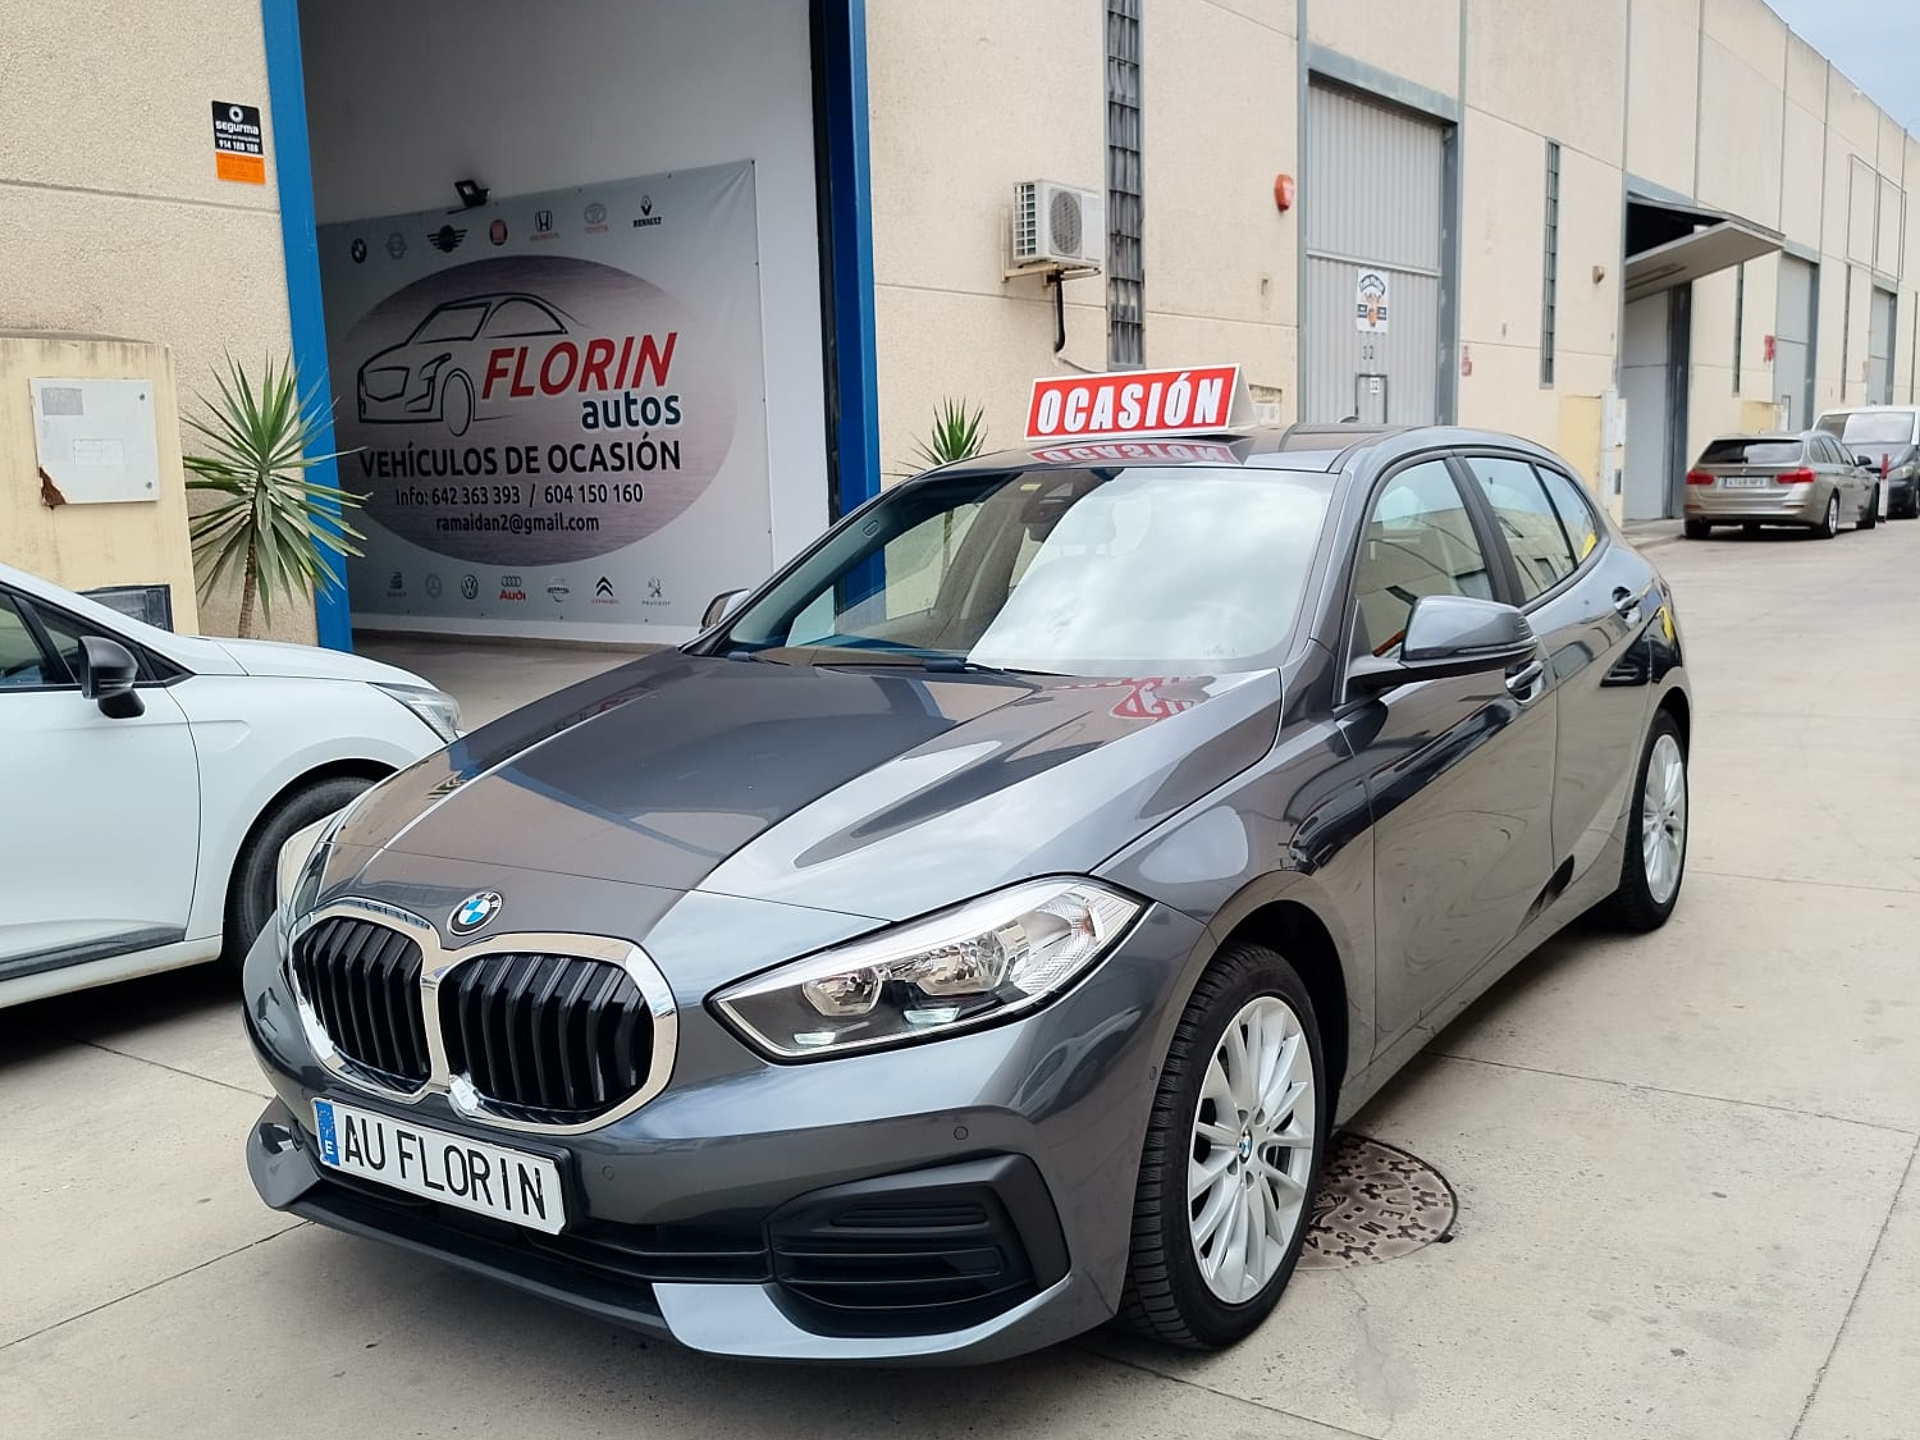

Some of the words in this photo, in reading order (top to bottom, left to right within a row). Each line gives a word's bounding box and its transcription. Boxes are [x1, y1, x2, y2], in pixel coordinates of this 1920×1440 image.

[215, 121, 259, 135] segurma
[481, 332, 678, 399] FLORIN
[581, 391, 682, 429] autos
[1037, 372, 1224, 434] OCASIÓN
[359, 442, 498, 478] VEHÍCULOS
[505, 446, 541, 475] DE
[547, 432, 681, 474] OCASIÓN
[396, 485, 429, 506] Info:
[432, 487, 458, 505] 642
[462, 486, 488, 505] 363
[493, 485, 521, 504] 393
[544, 485, 573, 504] 604
[579, 484, 608, 503] 150
[613, 483, 643, 503] 160
[436, 513, 600, 535] ramaidan2@gmail.com
[500, 589, 526, 600] Audi
[324, 1140, 335, 1155] E
[345, 1115, 386, 1170] AU
[396, 1130, 546, 1220] FLORIN
